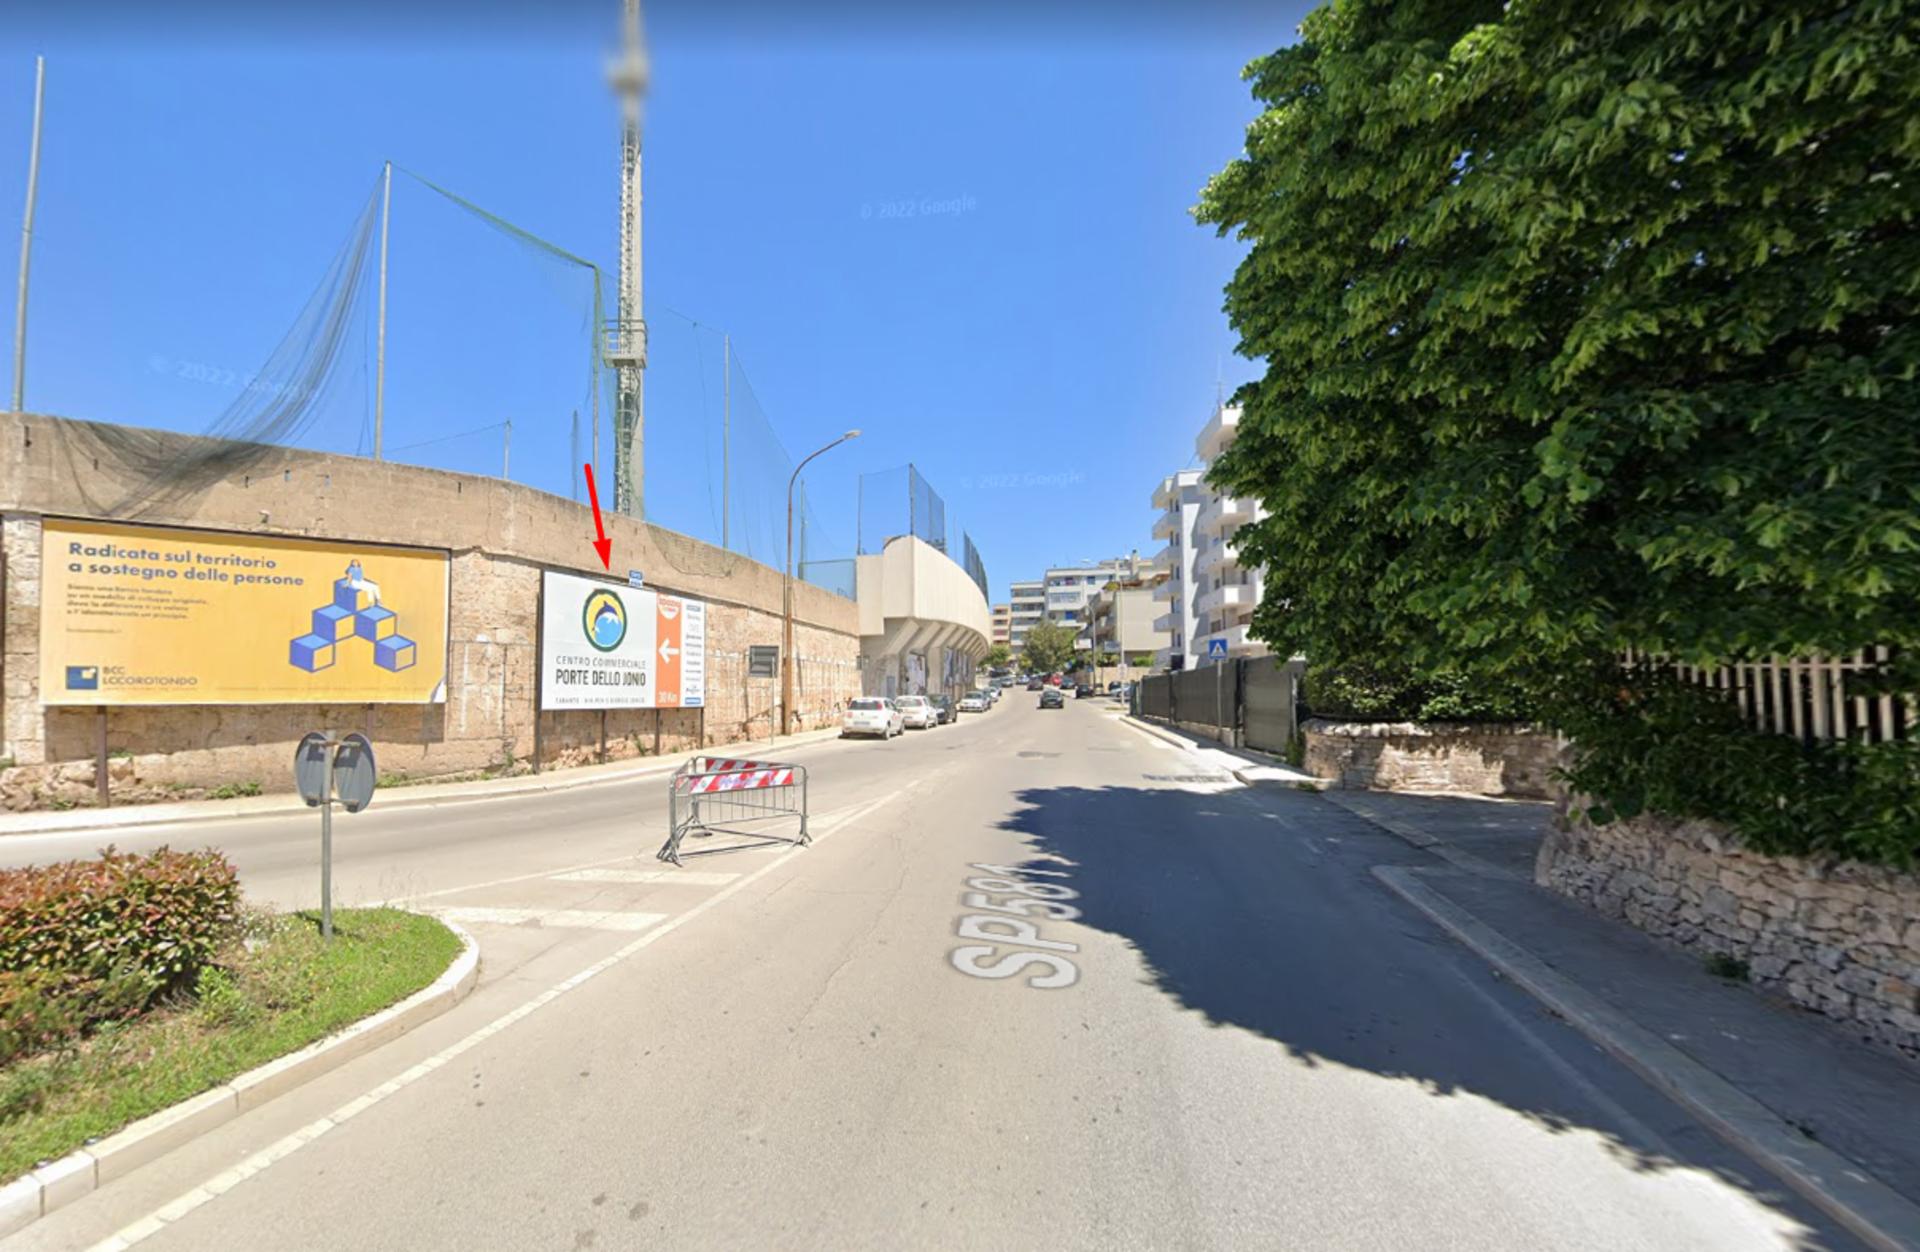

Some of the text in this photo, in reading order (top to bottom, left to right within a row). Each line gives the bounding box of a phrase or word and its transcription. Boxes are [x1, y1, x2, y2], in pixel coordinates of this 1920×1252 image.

[68, 542, 277, 570] Radicata sul territorio
[68, 560, 304, 587] a sostegno delle persone
[556, 655, 646, 670] CENTRO COMMERCIALE
[103, 676, 198, 686] LOCOROTONDO
[555, 669, 646, 687] PORTE DELLO JONIO
